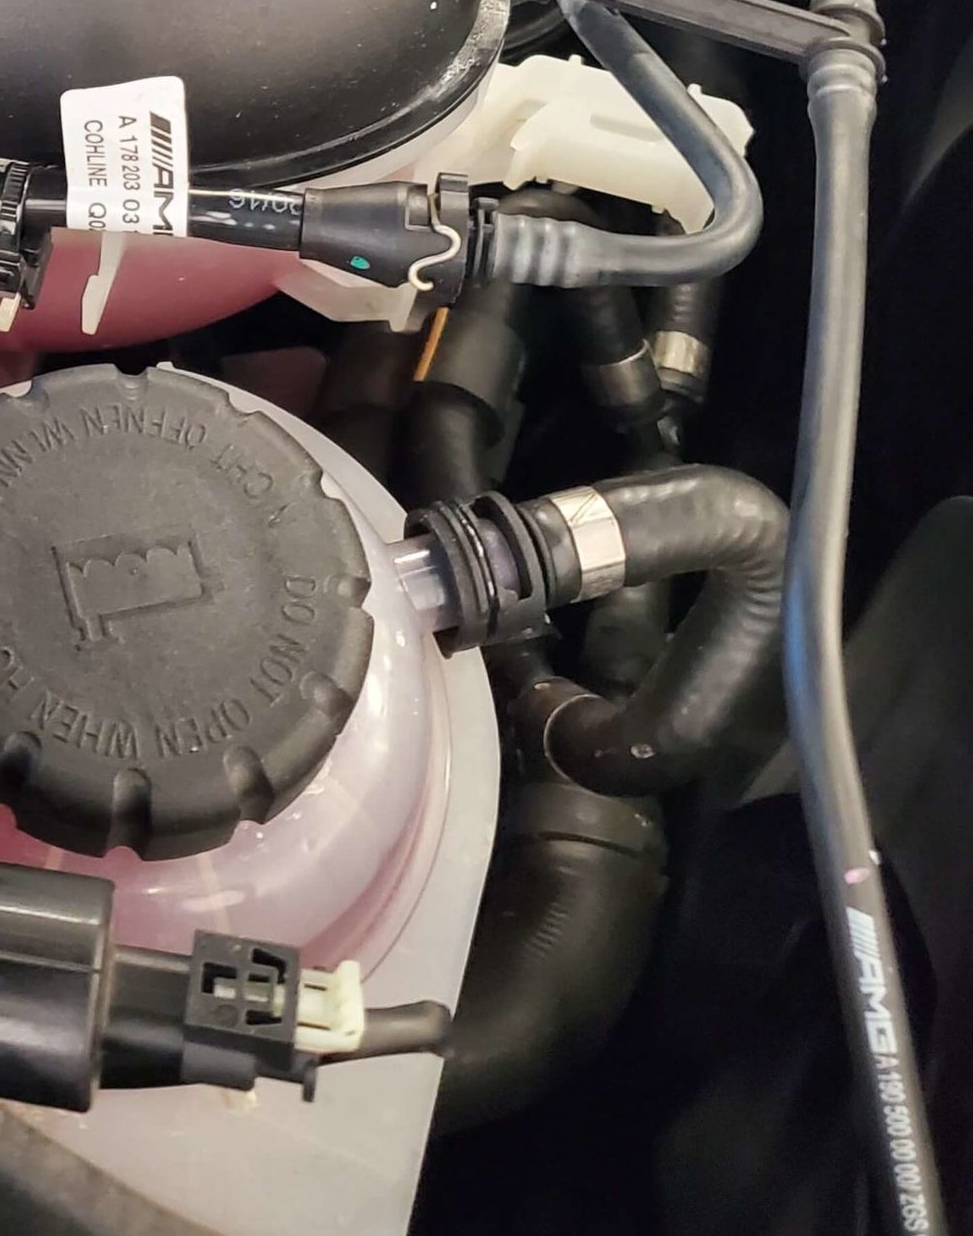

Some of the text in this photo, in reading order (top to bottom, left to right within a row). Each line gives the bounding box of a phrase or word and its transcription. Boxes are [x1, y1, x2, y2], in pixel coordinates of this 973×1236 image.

[118, 115, 137, 129] A
[120, 135, 139, 162] 178
[84, 120, 108, 232] COHLINE Q0
[122, 165, 141, 191] 203
[282, 575, 317, 625] DO
[249, 633, 309, 707] NOT
[29, 690, 141, 761] WHEN
[154, 698, 251, 759] OPEN
[855, 950, 898, 1053] AMG
[875, 1055, 899, 1070] A
[884, 1105, 912, 1137] 500
[890, 1138, 917, 1162] 00
[900, 1193, 929, 1231] ZGS
